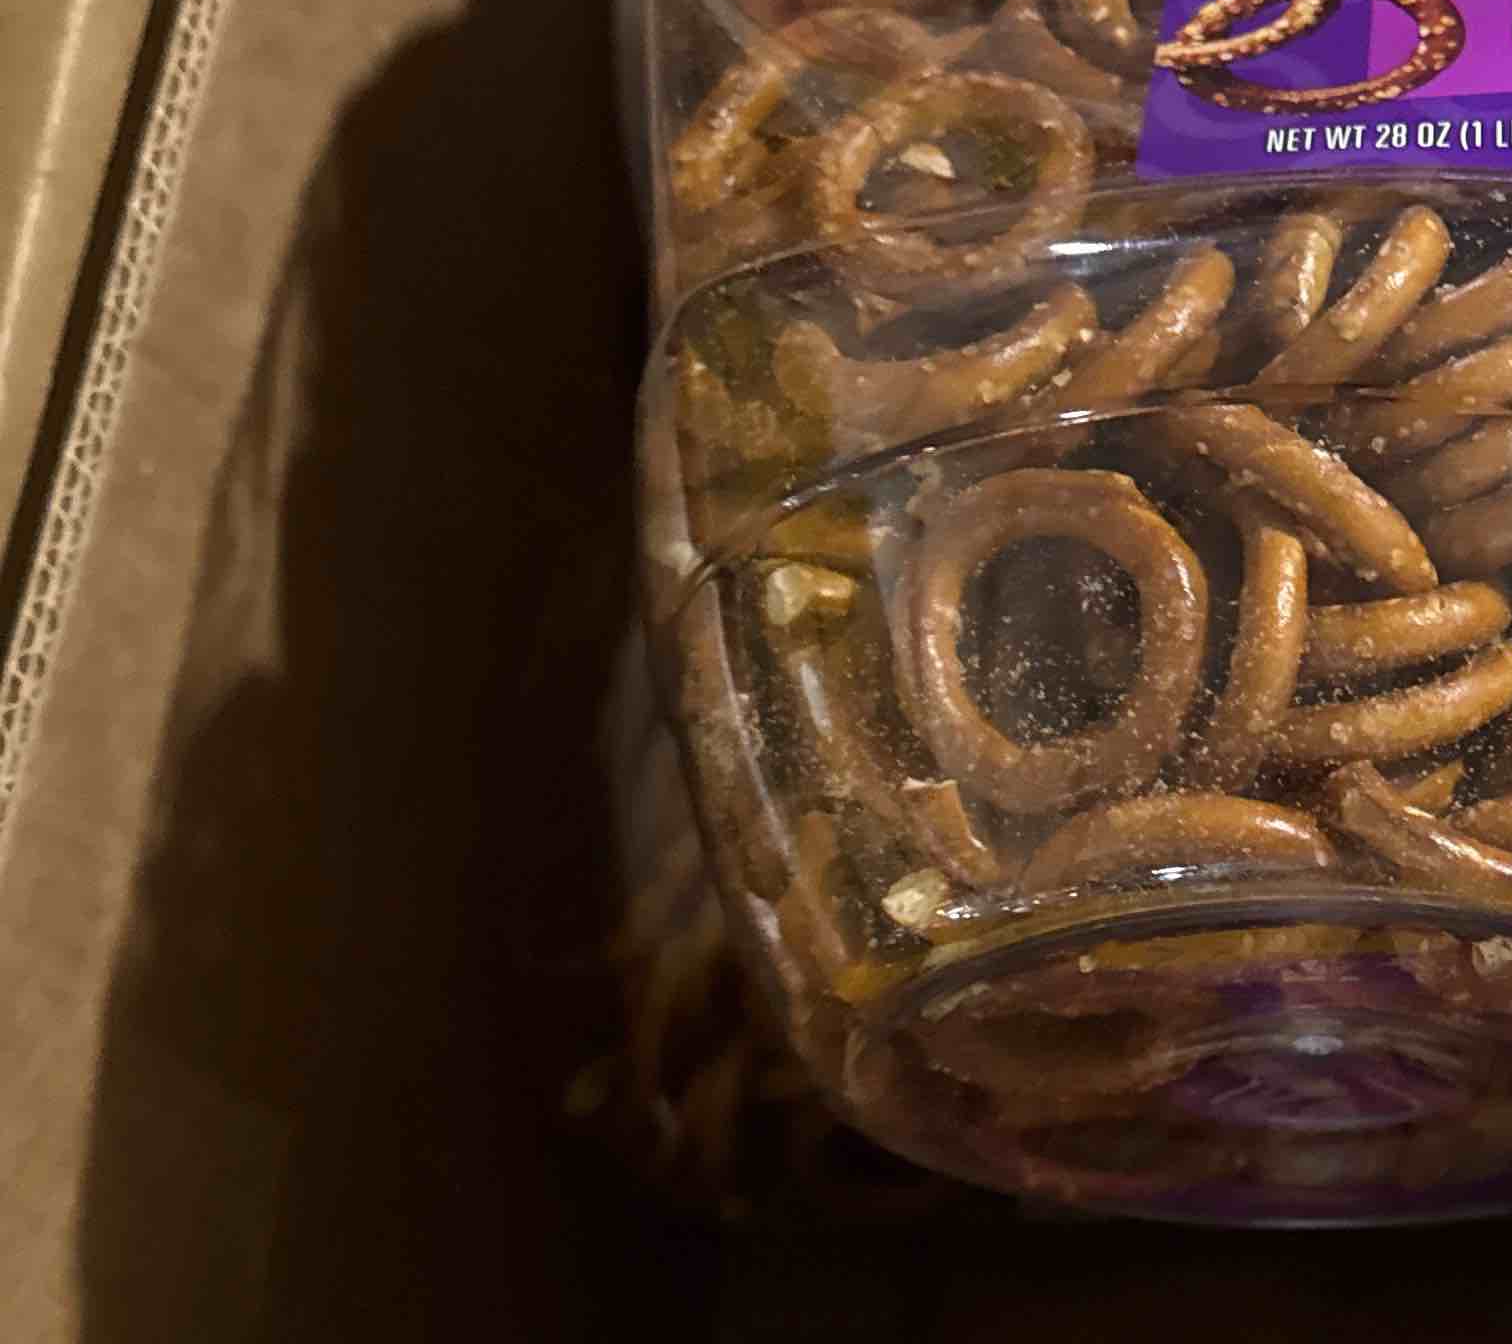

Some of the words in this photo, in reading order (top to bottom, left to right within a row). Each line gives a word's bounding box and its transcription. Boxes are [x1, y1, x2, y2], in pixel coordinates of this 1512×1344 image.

[1266, 128, 1315, 152] NET
[1325, 125, 1367, 150] WT
[1376, 123, 1406, 148] 28
[1417, 122, 1450, 147] OZ
[1460, 120, 1482, 150] (1
